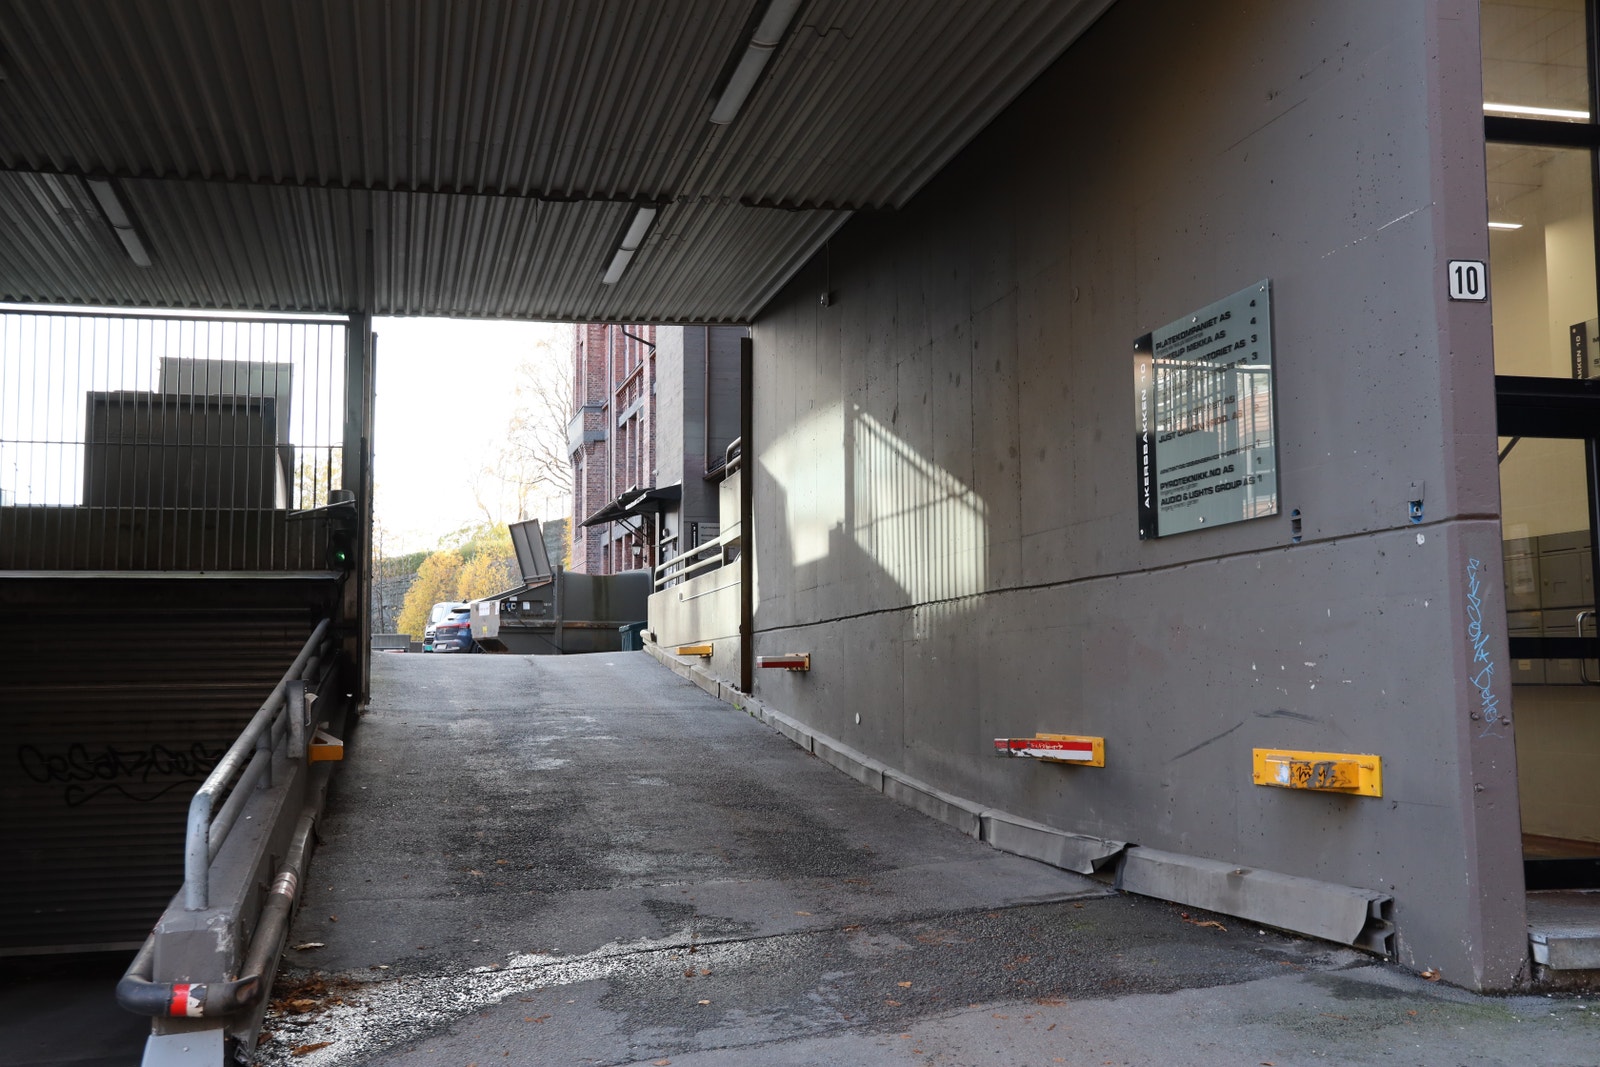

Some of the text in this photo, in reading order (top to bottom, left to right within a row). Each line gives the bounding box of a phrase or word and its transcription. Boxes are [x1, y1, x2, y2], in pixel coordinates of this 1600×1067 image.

[1455, 266, 1478, 295] 10
[1156, 317, 1218, 350] PLATEKOMPANIET
[1220, 311, 1231, 322] AS
[1187, 336, 1212, 352] MEKKA
[1215, 330, 1226, 340] AS
[1234, 339, 1246, 350] AS
[1141, 364, 1150, 508] AKERSBAKKEN 10
[1159, 432, 1176, 443] JUST
[1223, 464, 1234, 474] AS
[1161, 494, 1182, 505] AUDIO
[1189, 486, 1214, 499] LIGHTS
[1215, 480, 1242, 492] GROUP
[1244, 476, 1255, 486] AS
